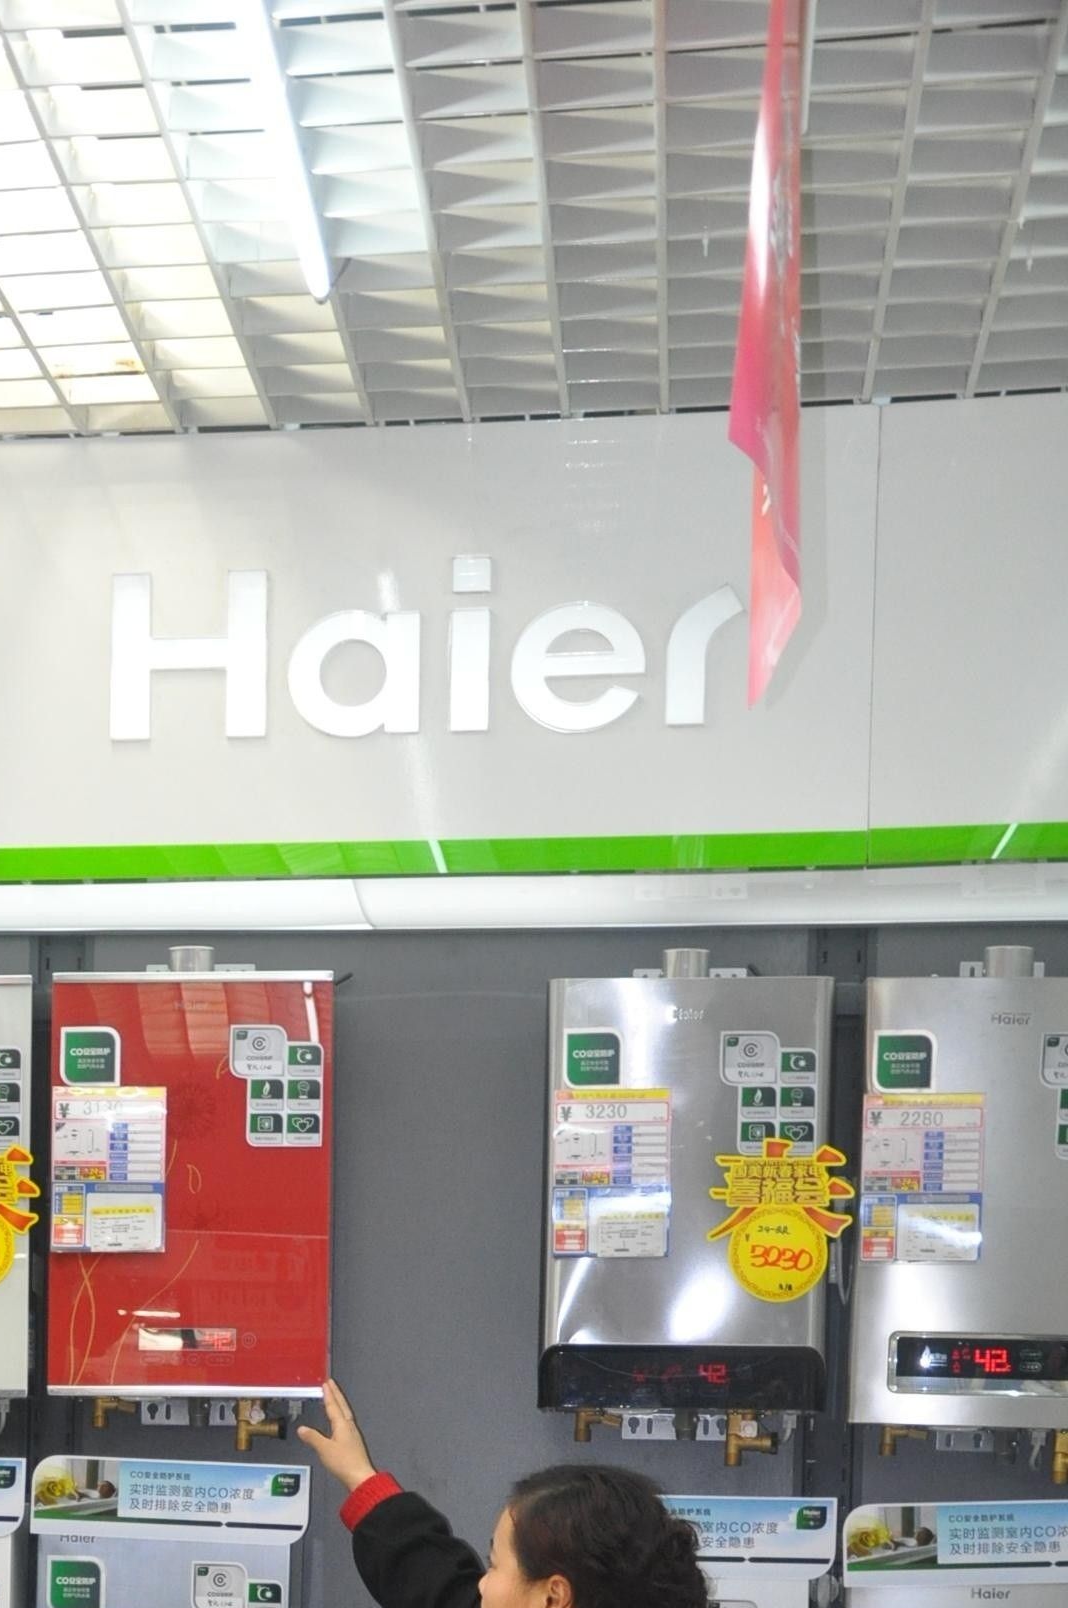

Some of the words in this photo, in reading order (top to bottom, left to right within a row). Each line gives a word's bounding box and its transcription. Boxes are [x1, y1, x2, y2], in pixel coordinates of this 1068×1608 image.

[110, 553, 744, 740] Haier
[990, 1012, 1031, 1026] Haier
[585, 1104, 628, 1119] 3230
[900, 1111, 944, 1127] 2280
[973, 1349, 1008, 1372] 42
[129, 1483, 255, 1501] 实时监测室内CO浓度
[128, 1499, 232, 1514] 及时排除安全隐患
[697, 1521, 779, 1534] 室内CO浓度
[950, 1542, 1061, 1556] 及时排除安全隐患
[970, 1587, 1011, 1600] Haier
